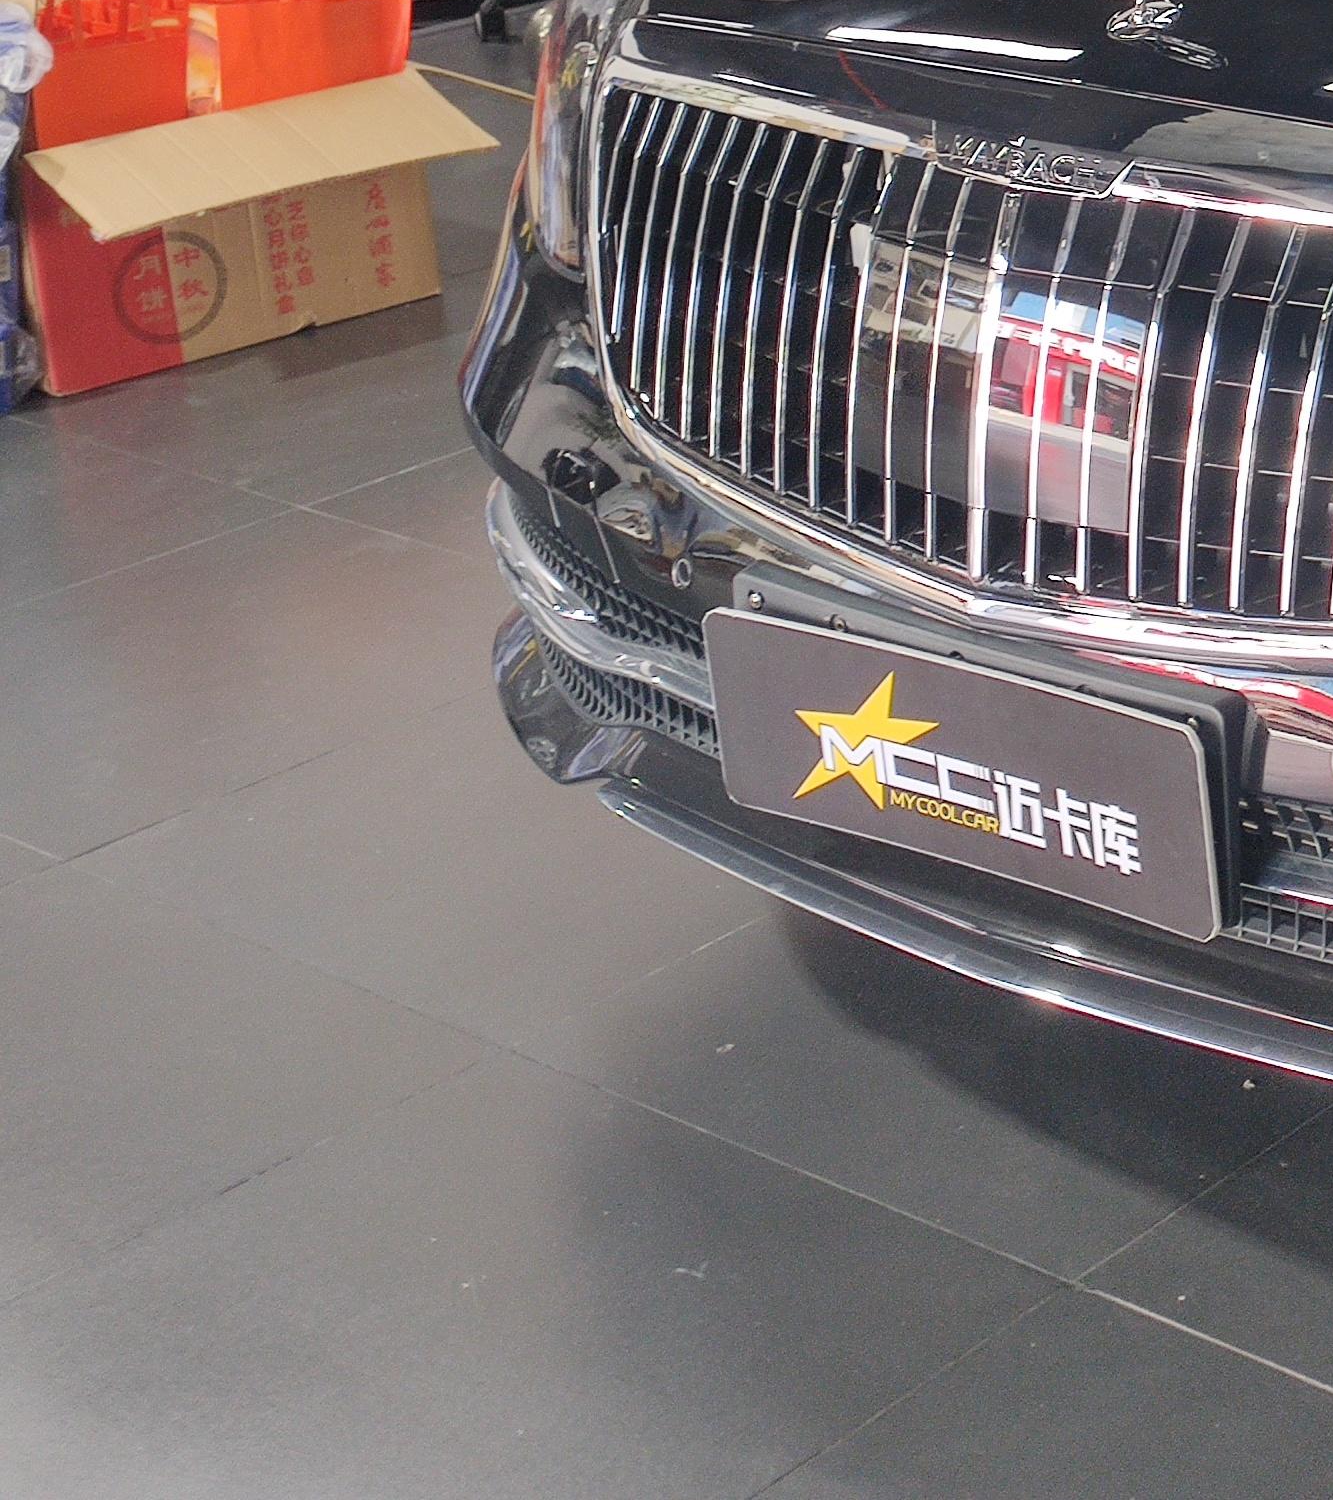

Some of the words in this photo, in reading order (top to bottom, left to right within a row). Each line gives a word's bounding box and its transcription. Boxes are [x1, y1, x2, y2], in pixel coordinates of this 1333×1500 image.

[890, 788, 1000, 836] MYCOOLCAR
[993, 769, 1142, 877] 迈卡库
